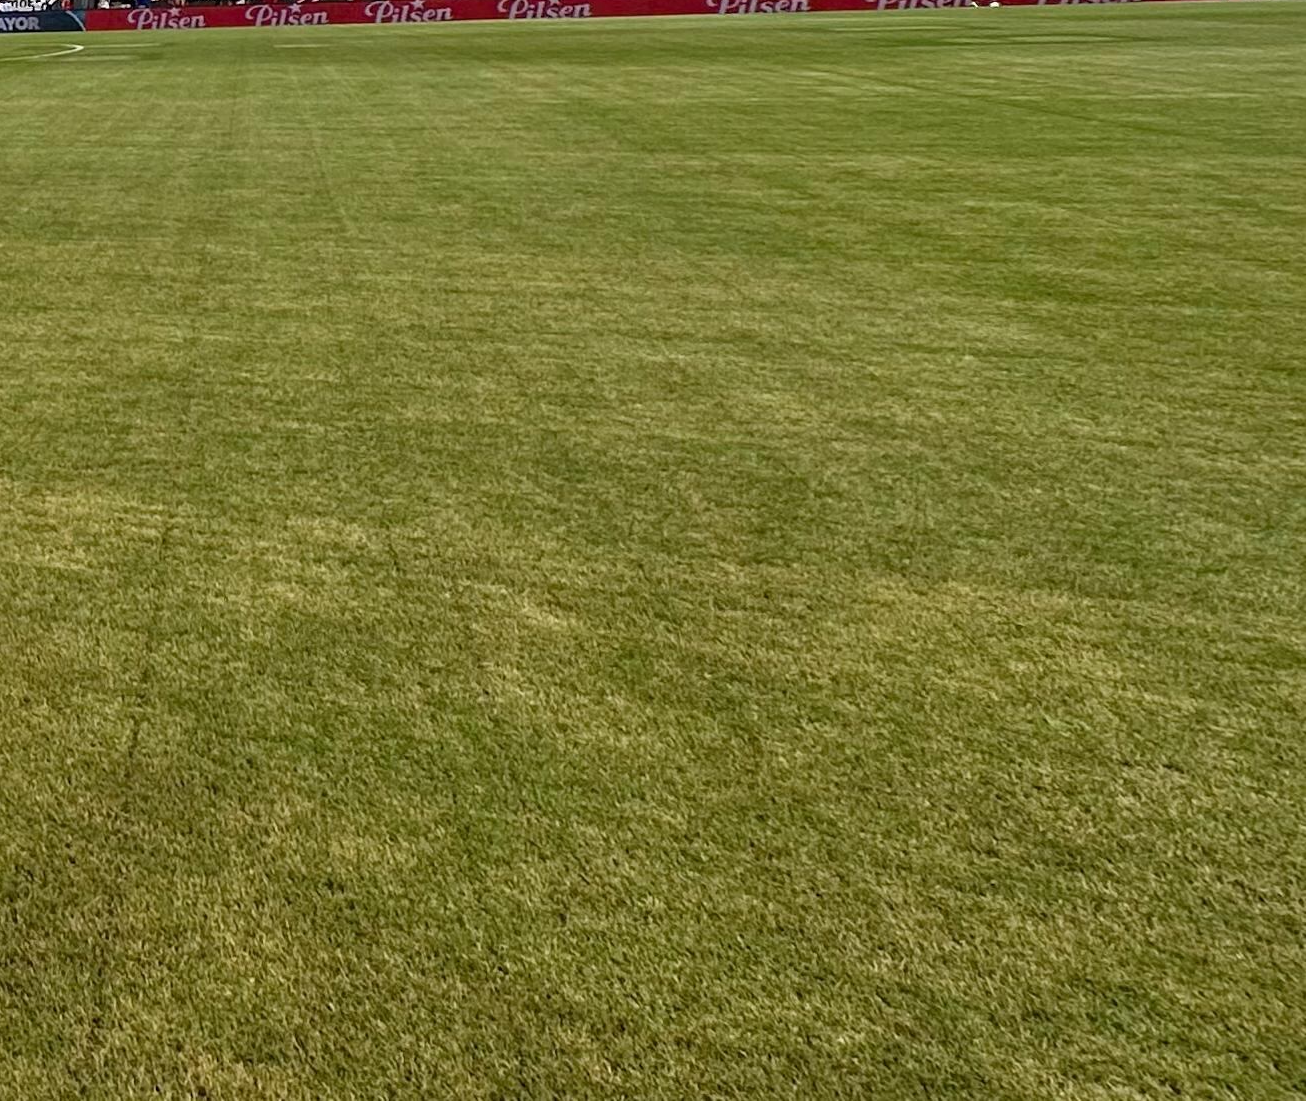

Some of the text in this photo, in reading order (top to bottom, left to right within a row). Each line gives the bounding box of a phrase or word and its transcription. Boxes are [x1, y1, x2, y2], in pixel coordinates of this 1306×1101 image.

[127, 7, 206, 29] Pilsen
[245, 4, 329, 27] Pilsen
[365, 0, 454, 23] Pilsen
